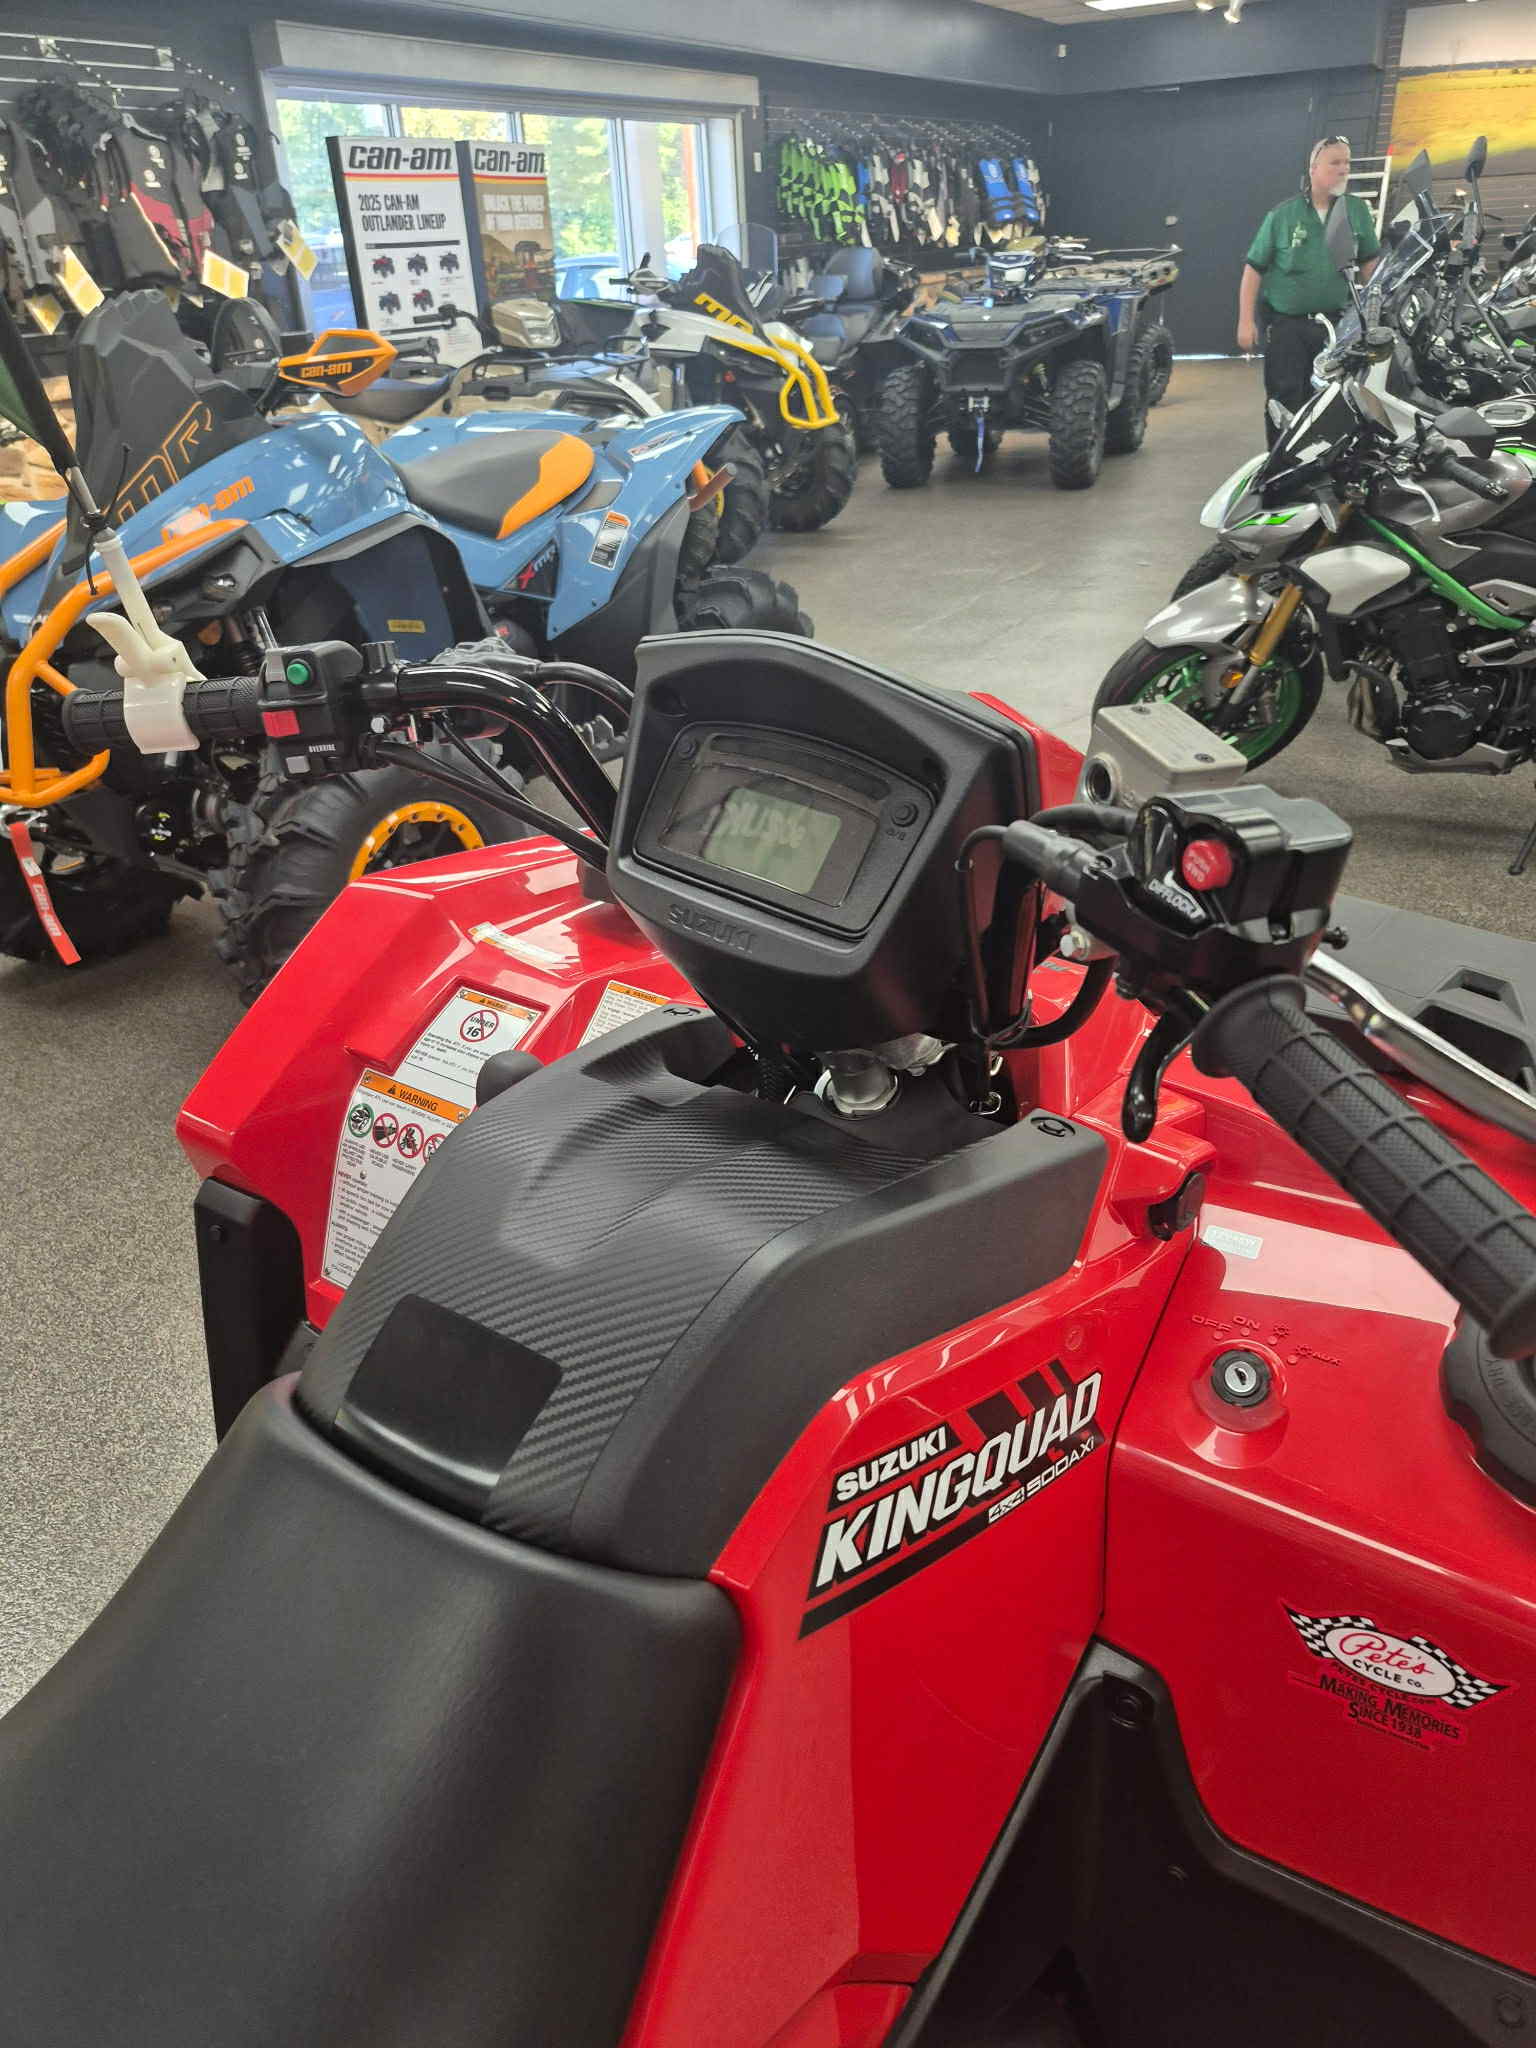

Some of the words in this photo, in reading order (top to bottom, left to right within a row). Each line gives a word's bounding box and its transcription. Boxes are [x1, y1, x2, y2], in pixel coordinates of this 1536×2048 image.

[349, 146, 451, 171] can-am
[474, 148, 545, 174] can-am
[358, 194, 382, 211] 2025
[384, 194, 420, 211] CAN-AM
[362, 213, 414, 232] OUTLANDER
[417, 213, 447, 231] LINEUP
[301, 362, 353, 378] can-am
[668, 904, 756, 953] SUZUKI
[466, 1026, 482, 1037] 16
[400, 1089, 438, 1111] WARNING
[1192, 1314, 1233, 1332] OFF
[1233, 1315, 1261, 1330] ON
[836, 1426, 947, 1502] SUZUKI
[815, 1371, 1102, 1588] KINGQUAD
[1339, 1632, 1434, 1676] Pete's
[1352, 1658, 1402, 1684] CYCLE
[1348, 1701, 1389, 1728] SINCE
[1384, 1697, 1460, 1740] MEMORIES
